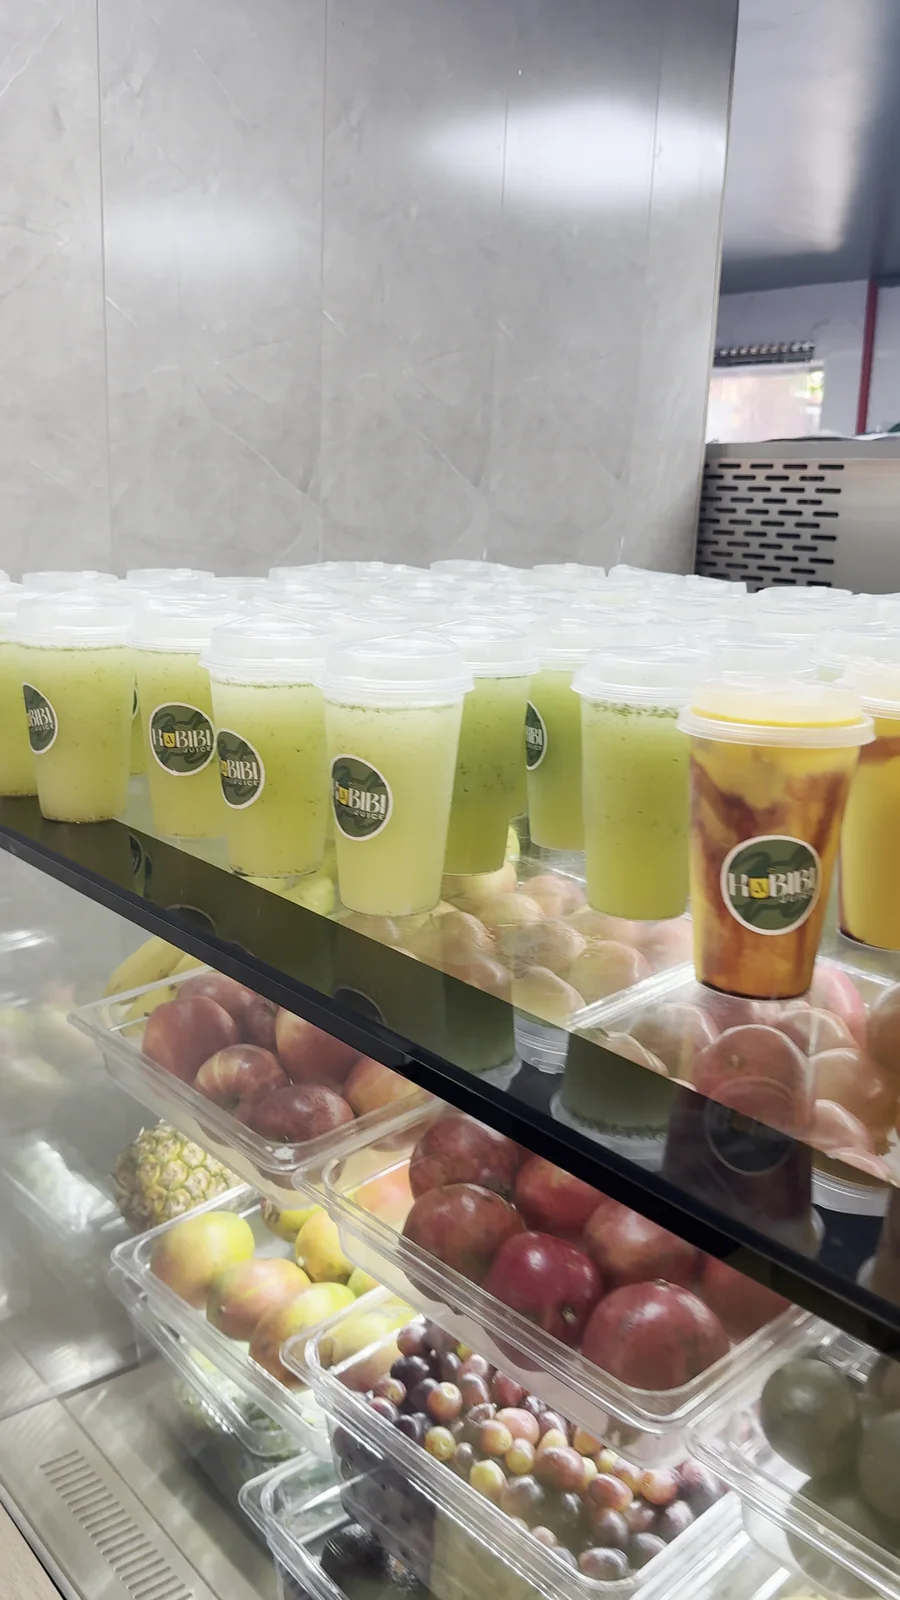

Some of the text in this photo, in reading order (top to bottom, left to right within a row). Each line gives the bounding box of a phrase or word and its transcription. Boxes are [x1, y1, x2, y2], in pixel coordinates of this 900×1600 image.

[26, 706, 53, 727] BIBI
[151, 728, 212, 749] HABIBI
[183, 746, 212, 754] JUICE
[728, 867, 815, 899] HABIBI
